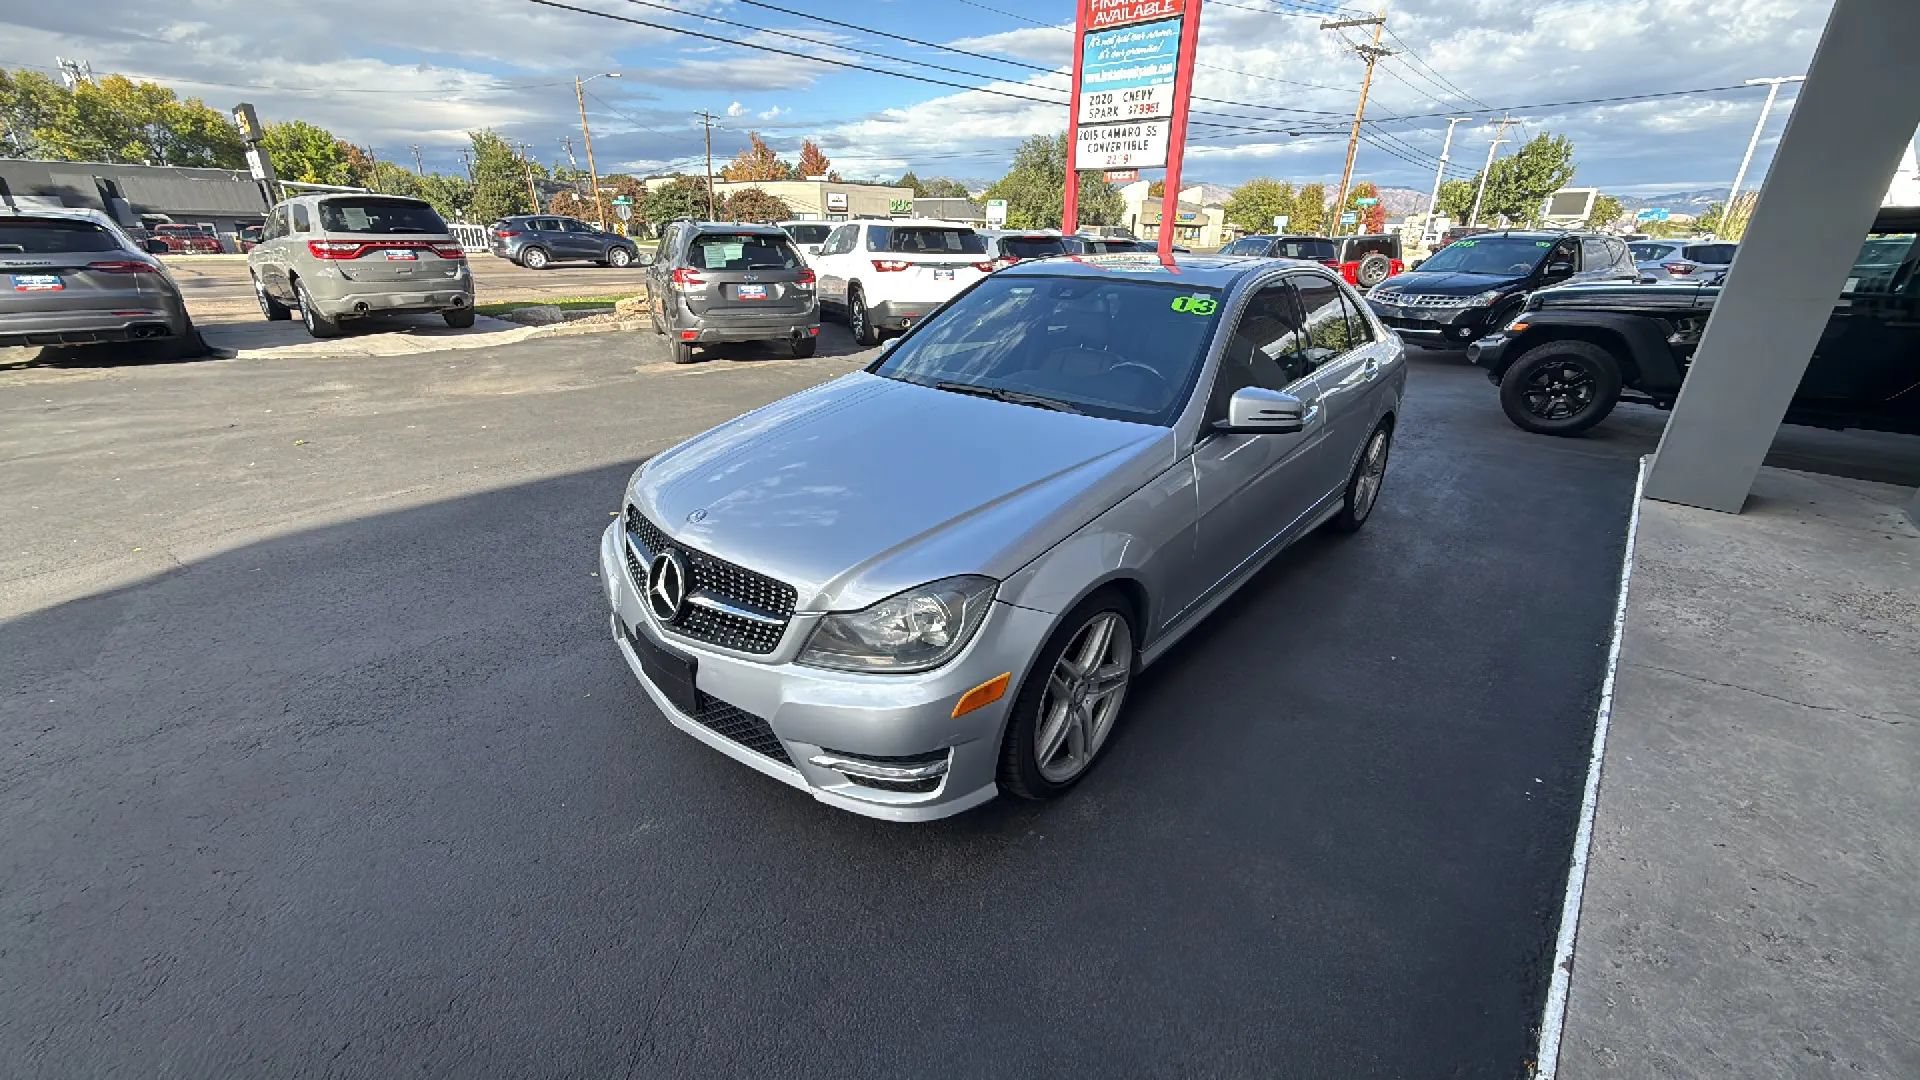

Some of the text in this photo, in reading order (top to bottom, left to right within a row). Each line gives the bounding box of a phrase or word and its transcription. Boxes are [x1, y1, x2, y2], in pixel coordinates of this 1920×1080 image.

[1094, 0, 1175, 25] AVAILABLE
[1089, 88, 1154, 106] 2020 CHEVY
[1089, 106, 1119, 119] SPARK
[1079, 125, 1158, 141] 2015 CAMARO SS
[1087, 140, 1149, 153] CONVERTIBLE
[1175, 297, 1216, 314] 13
